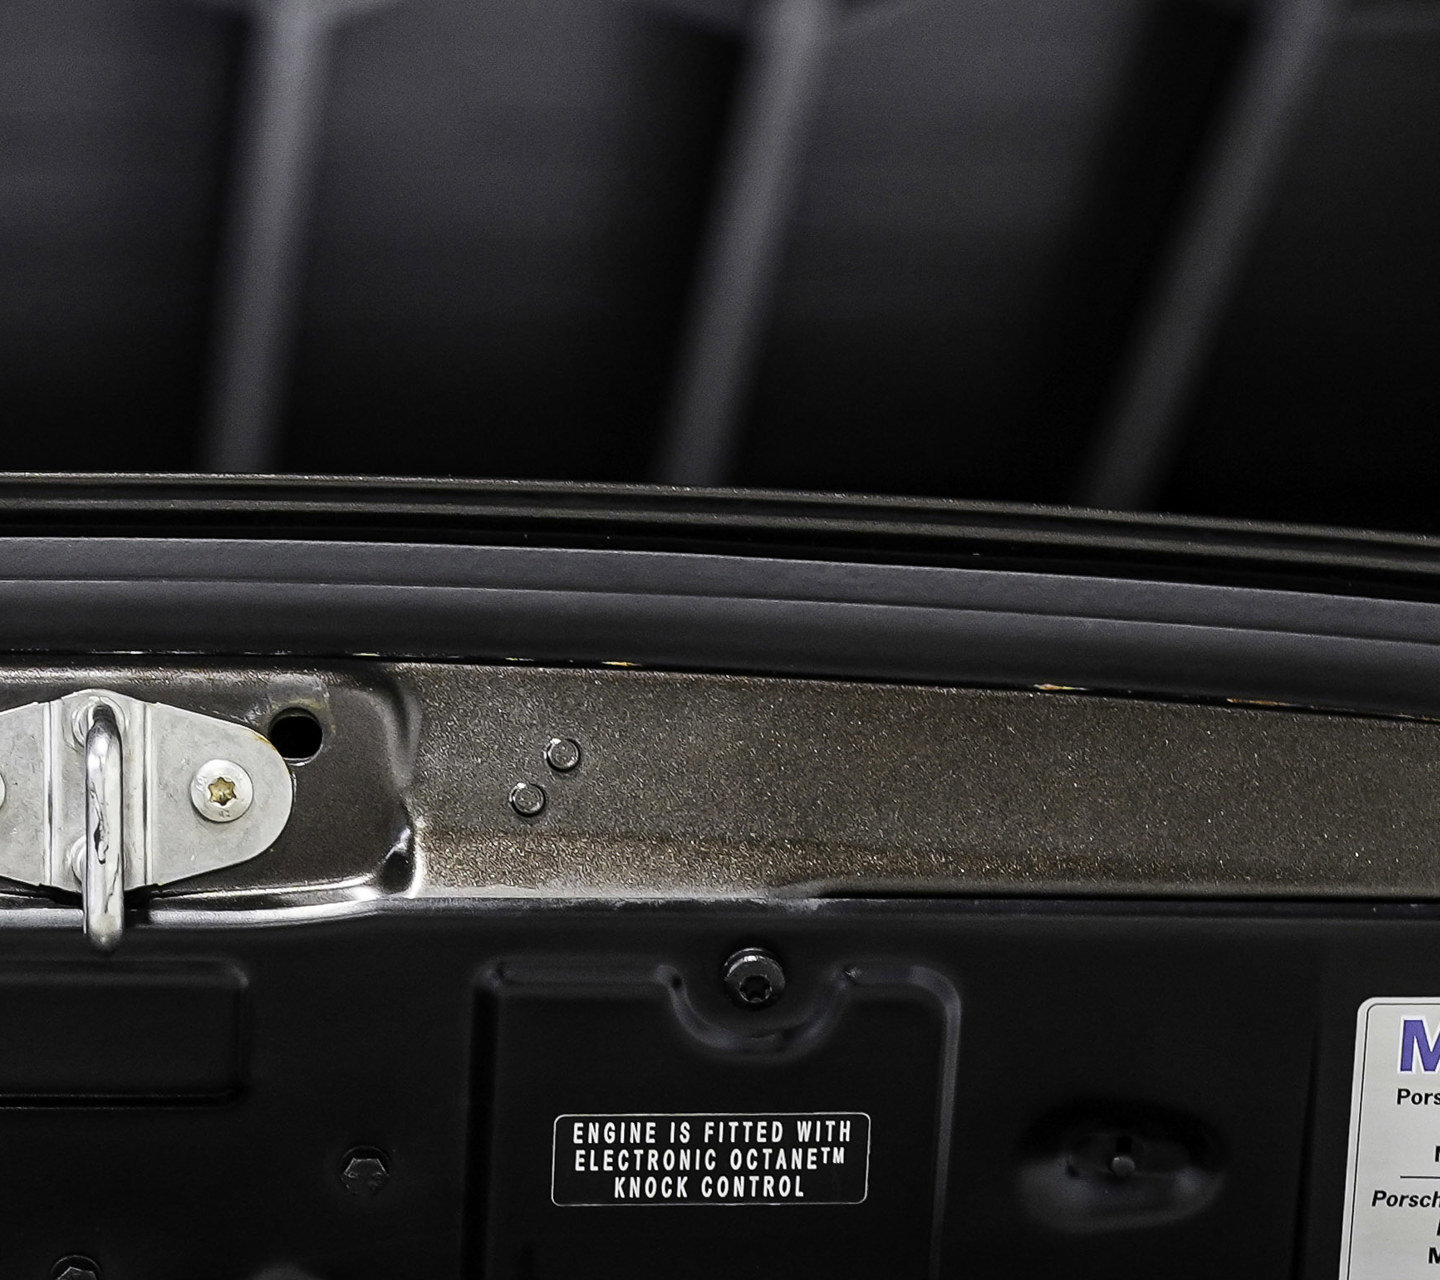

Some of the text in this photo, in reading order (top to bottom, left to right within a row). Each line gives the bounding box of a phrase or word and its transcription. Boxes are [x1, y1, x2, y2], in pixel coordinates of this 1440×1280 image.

[573, 1121, 850, 1143] ENGINE IS FITTED WITH
[575, 1149, 716, 1171] ELECTRONIC
[615, 1176, 803, 1198] KNOCK CONTROL
